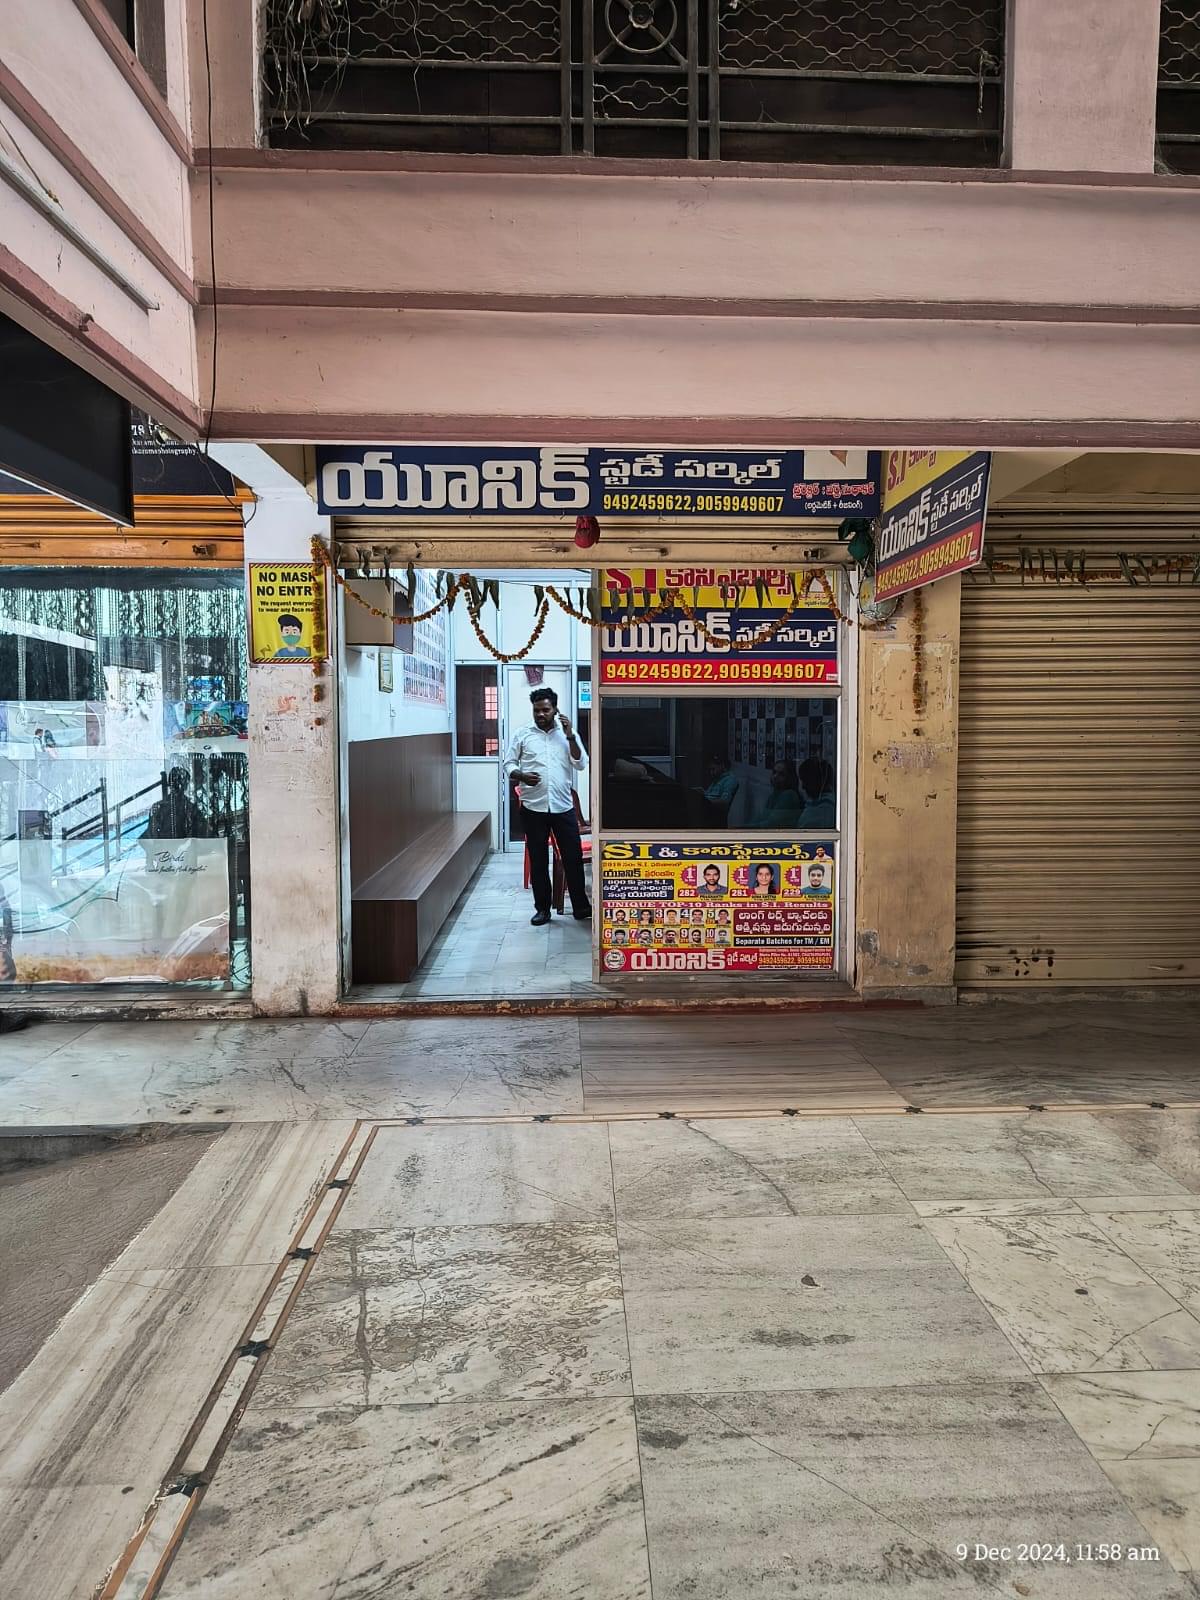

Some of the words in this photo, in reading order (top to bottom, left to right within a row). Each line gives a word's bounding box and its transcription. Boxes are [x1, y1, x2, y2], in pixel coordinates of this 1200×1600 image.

[322, 448, 590, 509] యూనిక్
[600, 454, 664, 486] స్టడీ
[675, 458, 783, 485] సర్కిల్
[603, 494, 784, 513] 9492459622,9059949607
[880, 487, 933, 562] యూనిక్
[930, 490, 950, 531] స్టడీ
[949, 472, 984, 511] సర్కిల్
[258, 572, 277, 582] NO
[256, 586, 275, 596] NO
[279, 586, 313, 596] ENTR
[776, 626, 837, 647] సర్కిల్
[606, 664, 825, 681] 9492459622,9059949607
[603, 844, 653, 859] SI
[659, 847, 679, 858] &
[679, 889, 695, 897] 282
[731, 889, 748, 897] 281
[735, 937, 765, 945] Separate
[766, 937, 792, 945] Batches
[793, 937, 803, 945] for
[631, 948, 725, 970] యూనిక్
